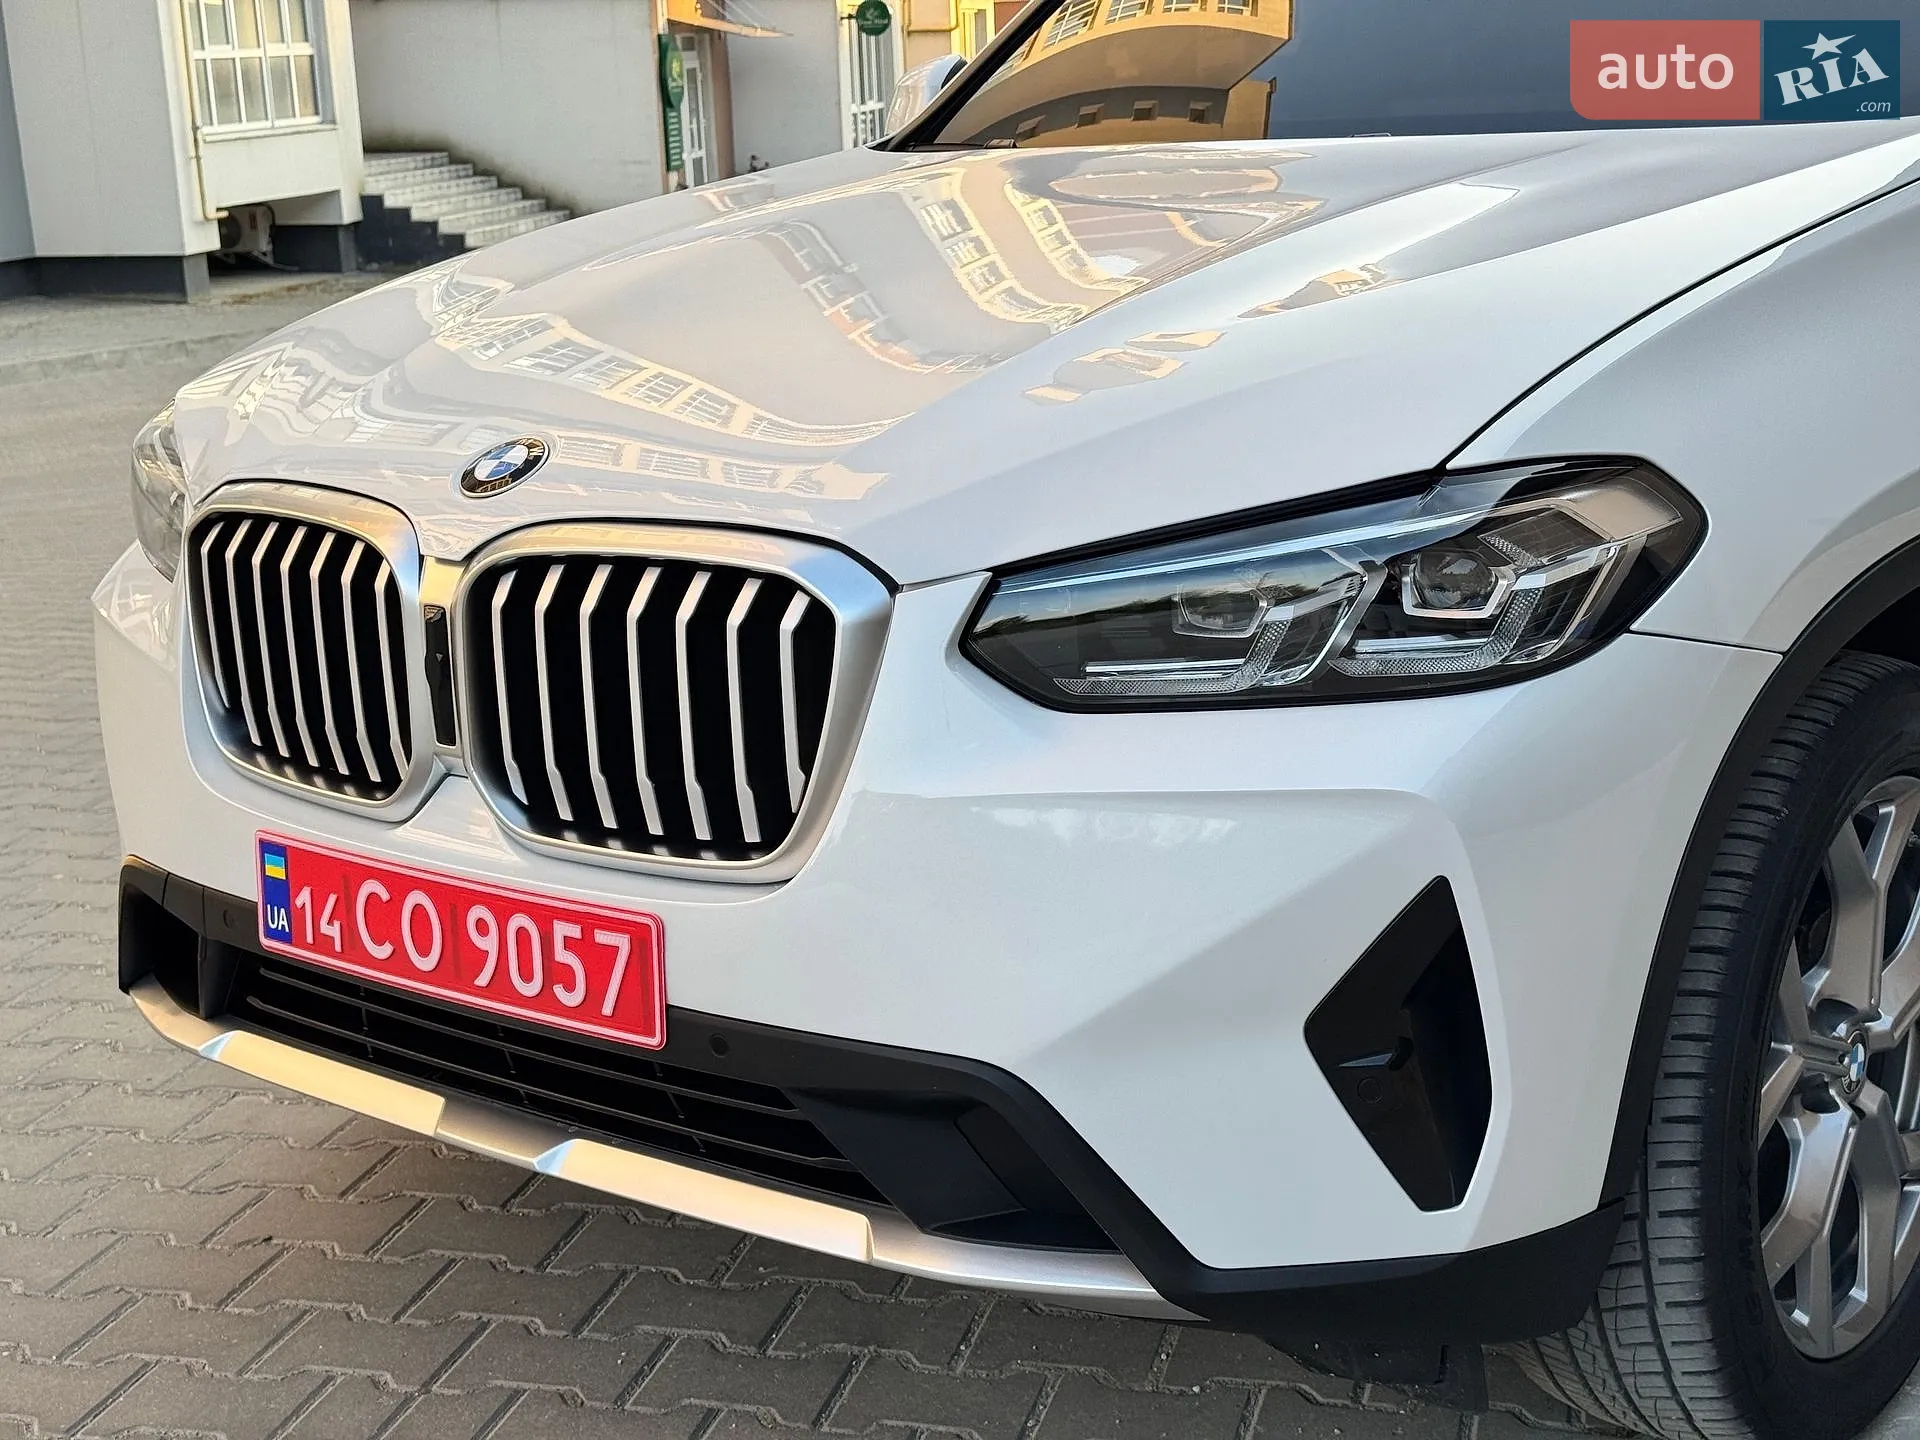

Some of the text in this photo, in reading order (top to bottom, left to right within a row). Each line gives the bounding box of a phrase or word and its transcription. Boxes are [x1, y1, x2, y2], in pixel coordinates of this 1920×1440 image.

[267, 904, 289, 934] UA
[295, 878, 632, 1017] 14 CO 9057
